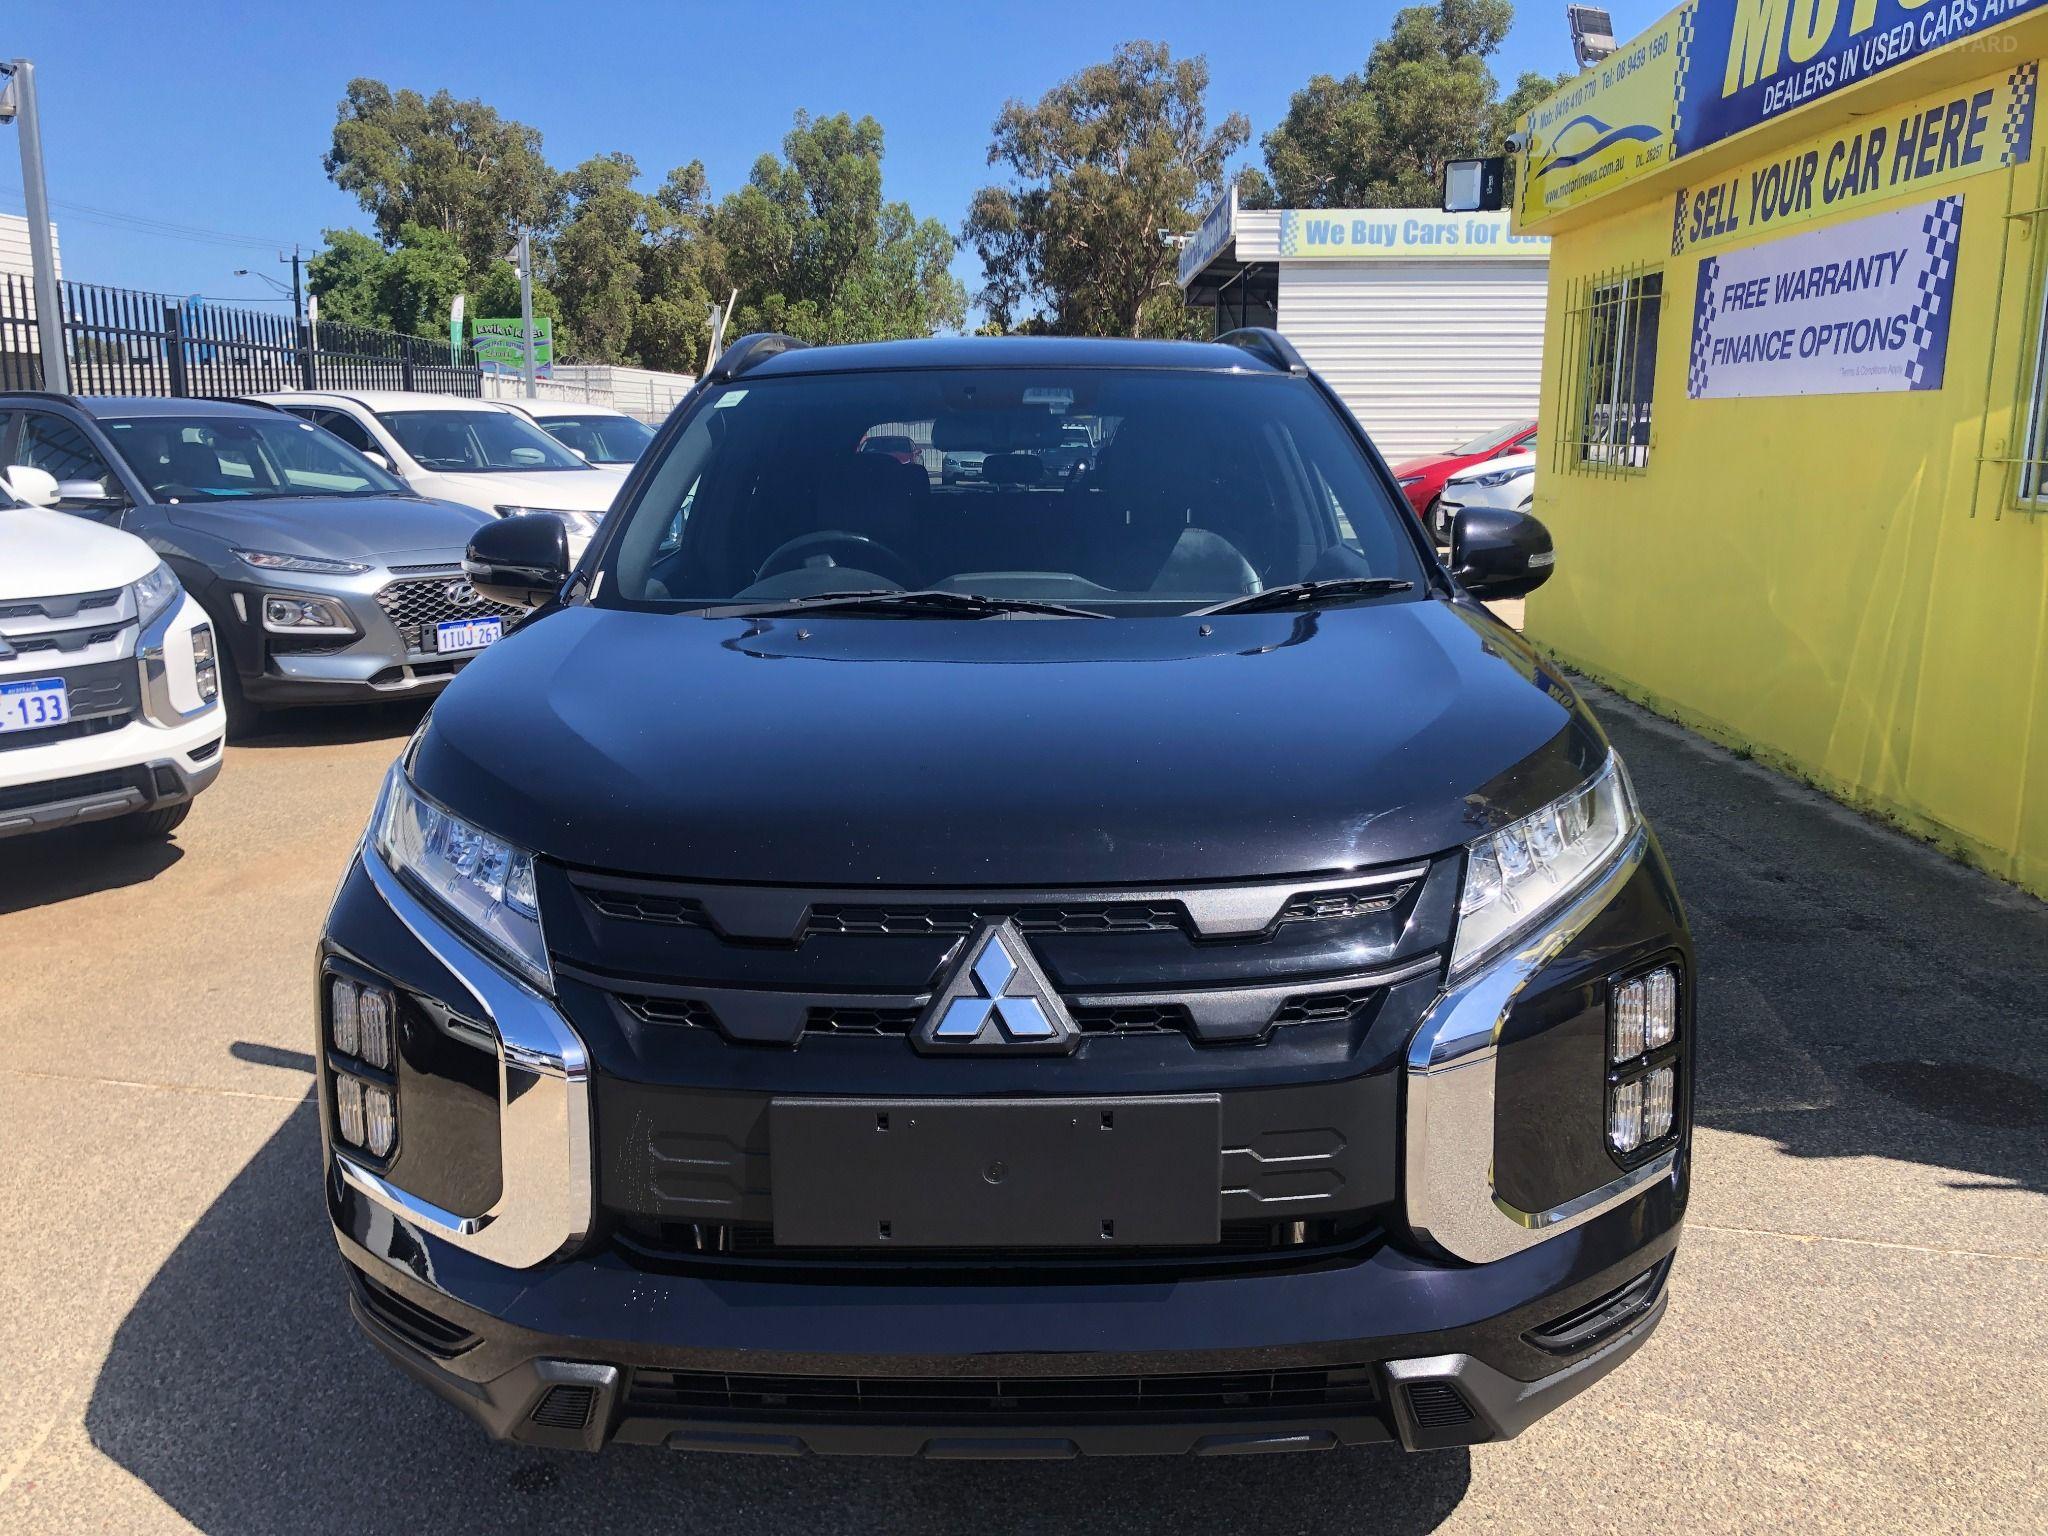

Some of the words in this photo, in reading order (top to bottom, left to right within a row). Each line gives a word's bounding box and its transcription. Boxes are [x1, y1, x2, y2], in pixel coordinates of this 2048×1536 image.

[1585, 79, 1597, 101] 770
[1602, 68, 1615, 91] Tel:
[1616, 60, 1625, 82] 08
[1627, 46, 1646, 76] 9459
[1649, 31, 1669, 62] 1560
[1762, 60, 1837, 115] DEALERS
[1840, 45, 1859, 82] IN
[1863, 22, 1915, 71] USED
[1920, 0, 1978, 46] CARS
[1689, 178, 1739, 243] SELL
[1748, 151, 1818, 226] YOUR
[1823, 126, 1887, 204] CAR
[1890, 88, 1995, 186] HERE
[1306, 219, 1345, 245] We
[1351, 219, 1398, 247] Buy
[1402, 219, 1459, 245] Cars
[1465, 219, 1501, 245] for
[1721, 277, 1771, 313] FREE
[1774, 248, 1908, 304] WARRANTY
[1711, 329, 1796, 366] FINANCE
[1799, 314, 1909, 359] OPTIONS
